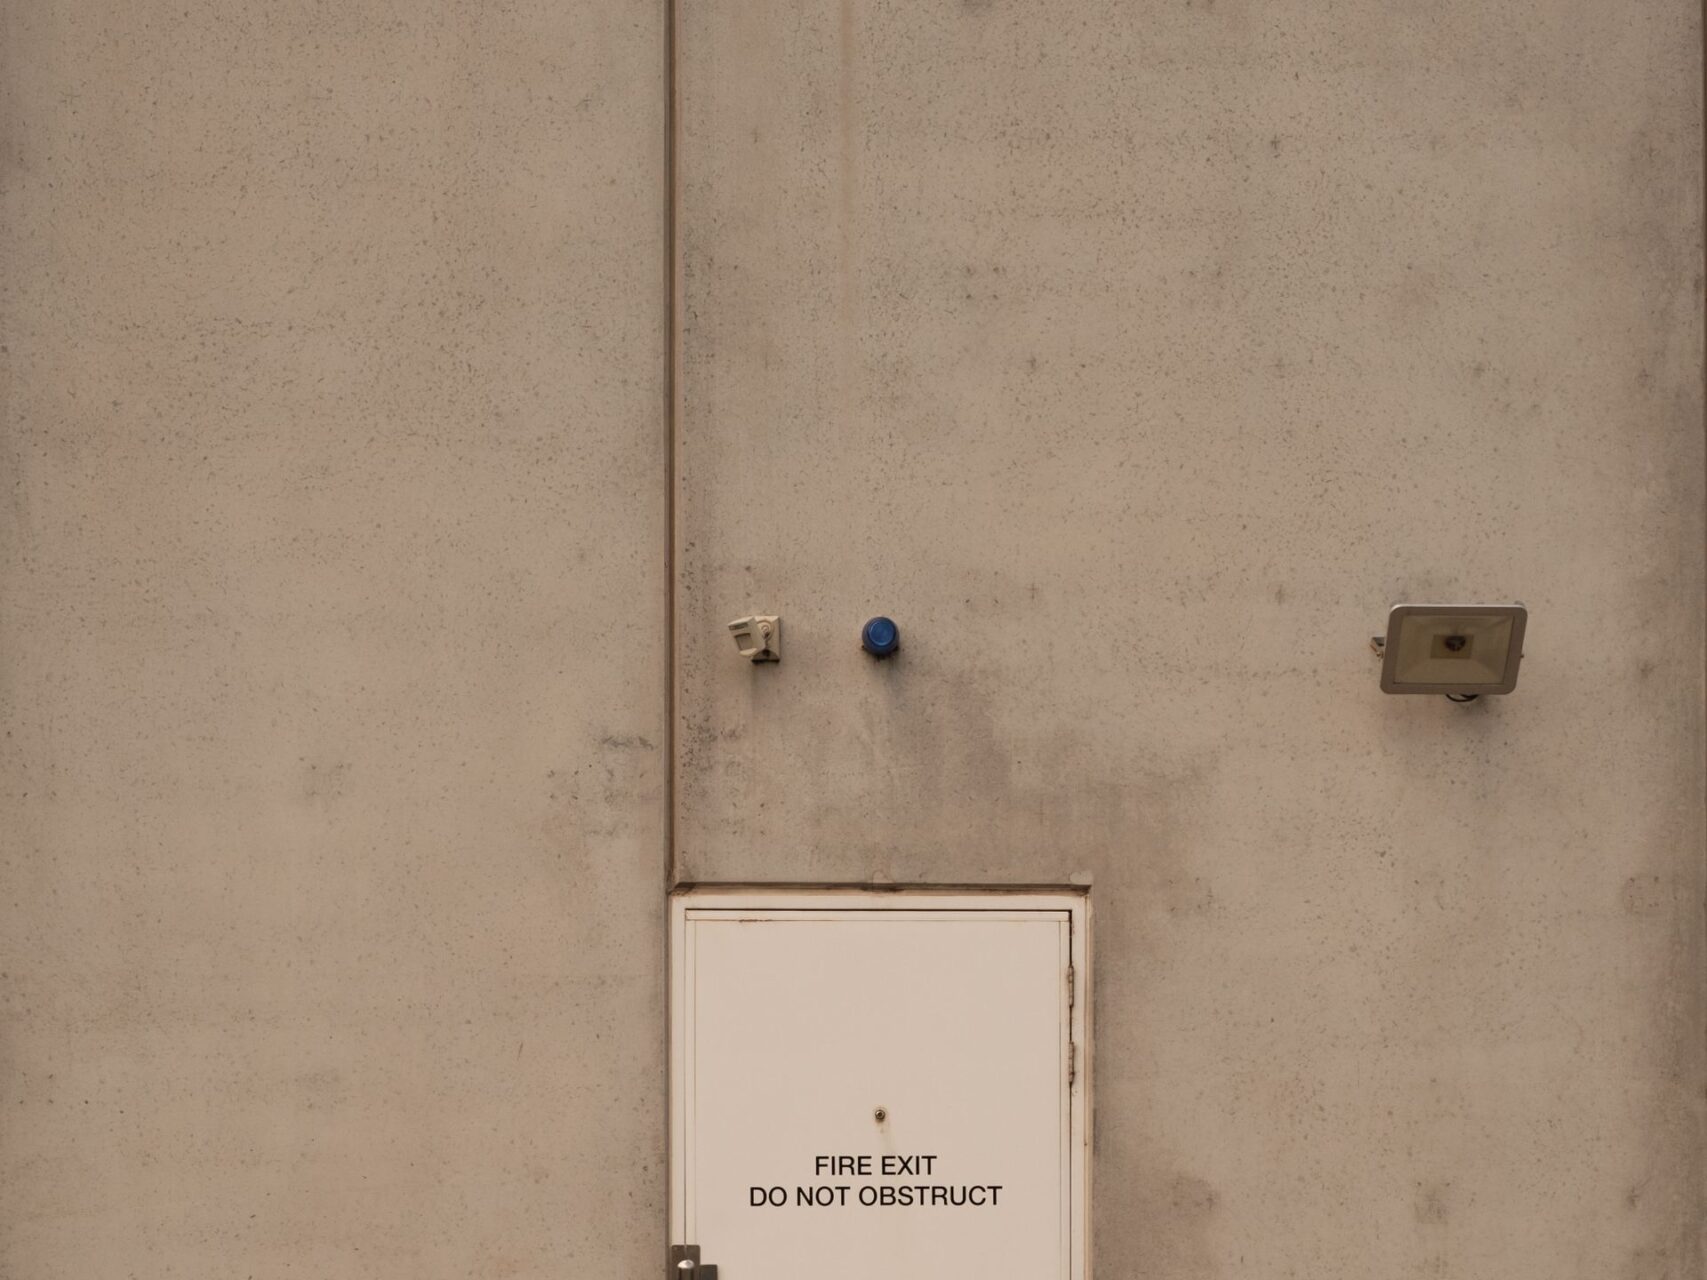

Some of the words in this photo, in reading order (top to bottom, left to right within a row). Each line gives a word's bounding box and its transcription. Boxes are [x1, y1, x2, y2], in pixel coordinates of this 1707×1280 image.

[815, 1155, 873, 1176] FIRE
[881, 1155, 938, 1176] EXIT
[749, 1186, 788, 1207] DO
[796, 1186, 851, 1207] NOT
[858, 1185, 1003, 1207] OBSTRUCT
